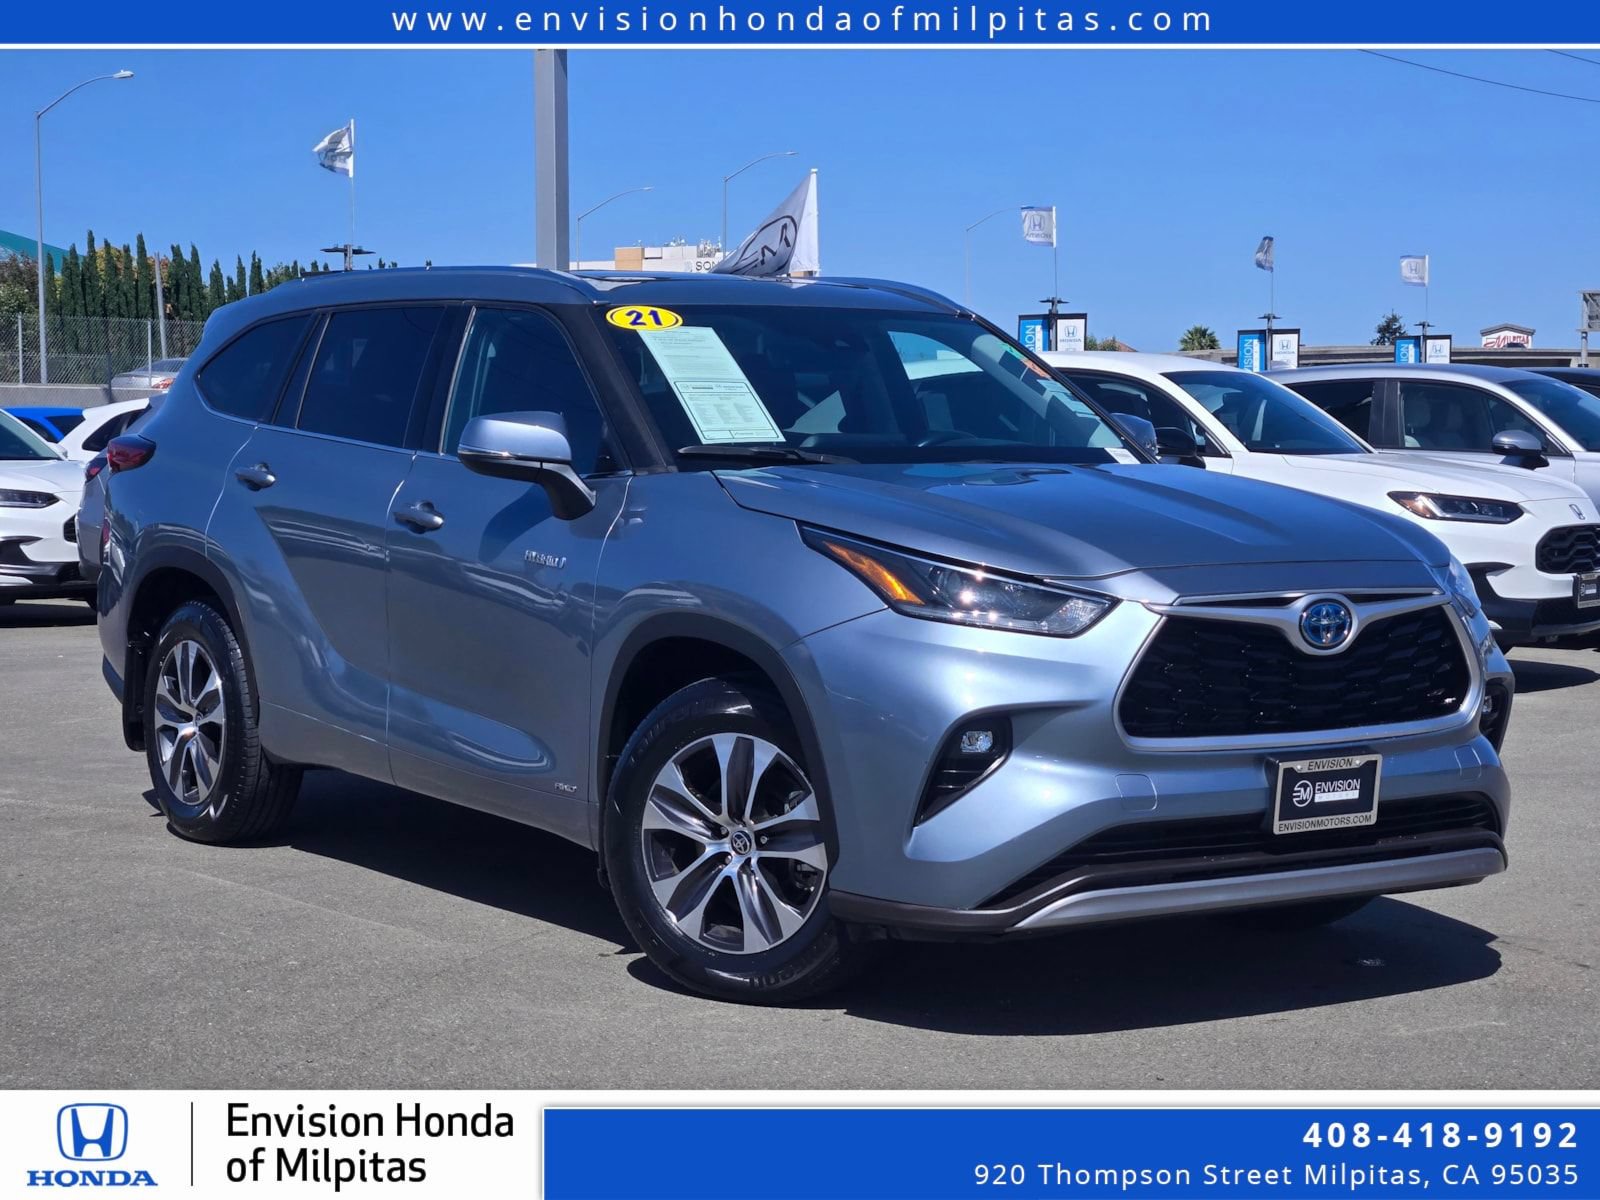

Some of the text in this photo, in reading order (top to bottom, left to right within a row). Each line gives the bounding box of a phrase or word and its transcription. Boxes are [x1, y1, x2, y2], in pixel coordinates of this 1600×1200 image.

[625, 310, 663, 326] 21
[1243, 339, 1253, 370] ISION
[1308, 758, 1353, 770] ENVISION
[1315, 779, 1360, 793] ENVISION
[1279, 815, 1372, 832] ENVISIONMOTORS.COM
